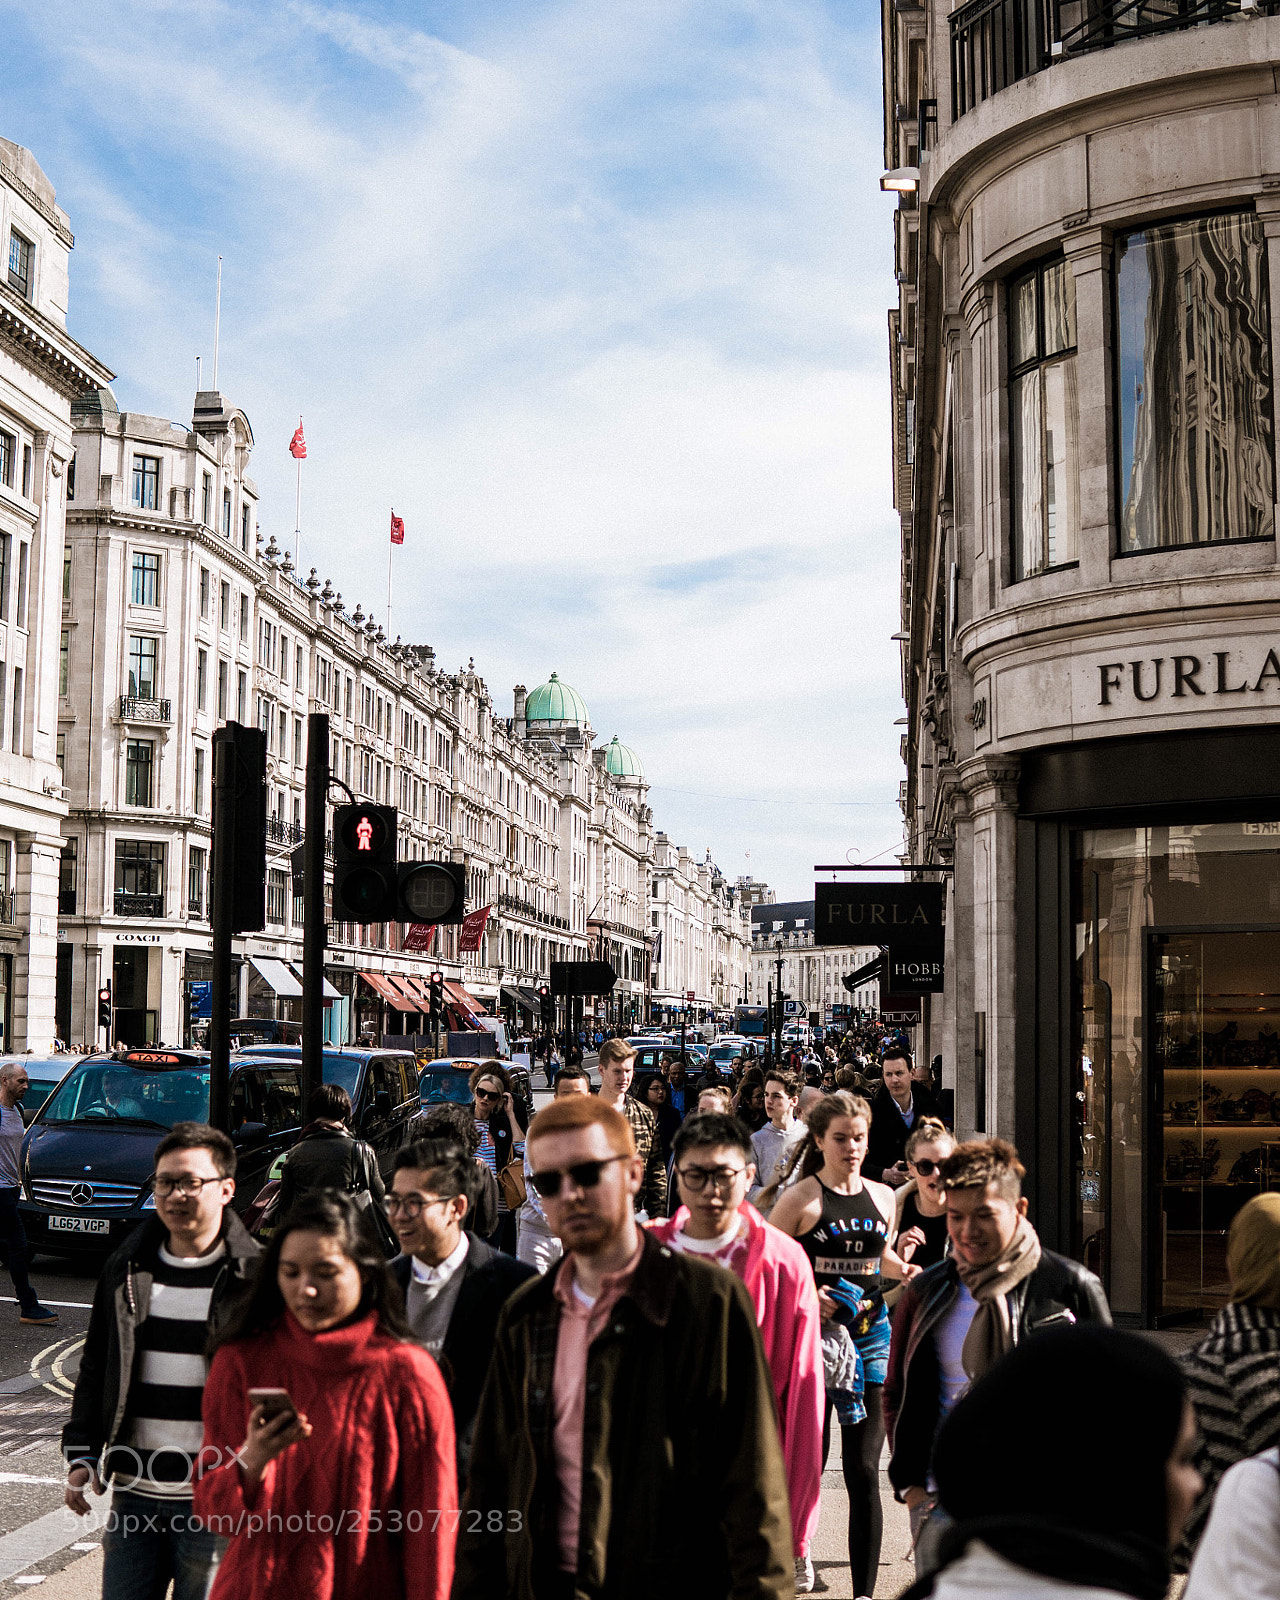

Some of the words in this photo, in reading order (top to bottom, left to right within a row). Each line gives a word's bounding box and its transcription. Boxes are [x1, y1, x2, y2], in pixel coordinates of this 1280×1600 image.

[1097, 648, 1280, 706] FURLA
[827, 903, 930, 925] FURLA
[116, 934, 161, 942] COACH
[788, 1002, 794, 1011] P
[138, 1054, 169, 1063] TAXI
[52, 1217, 81, 1230] LG62
[84, 1220, 105, 1231] VGP
[845, 1240, 864, 1253] TO
